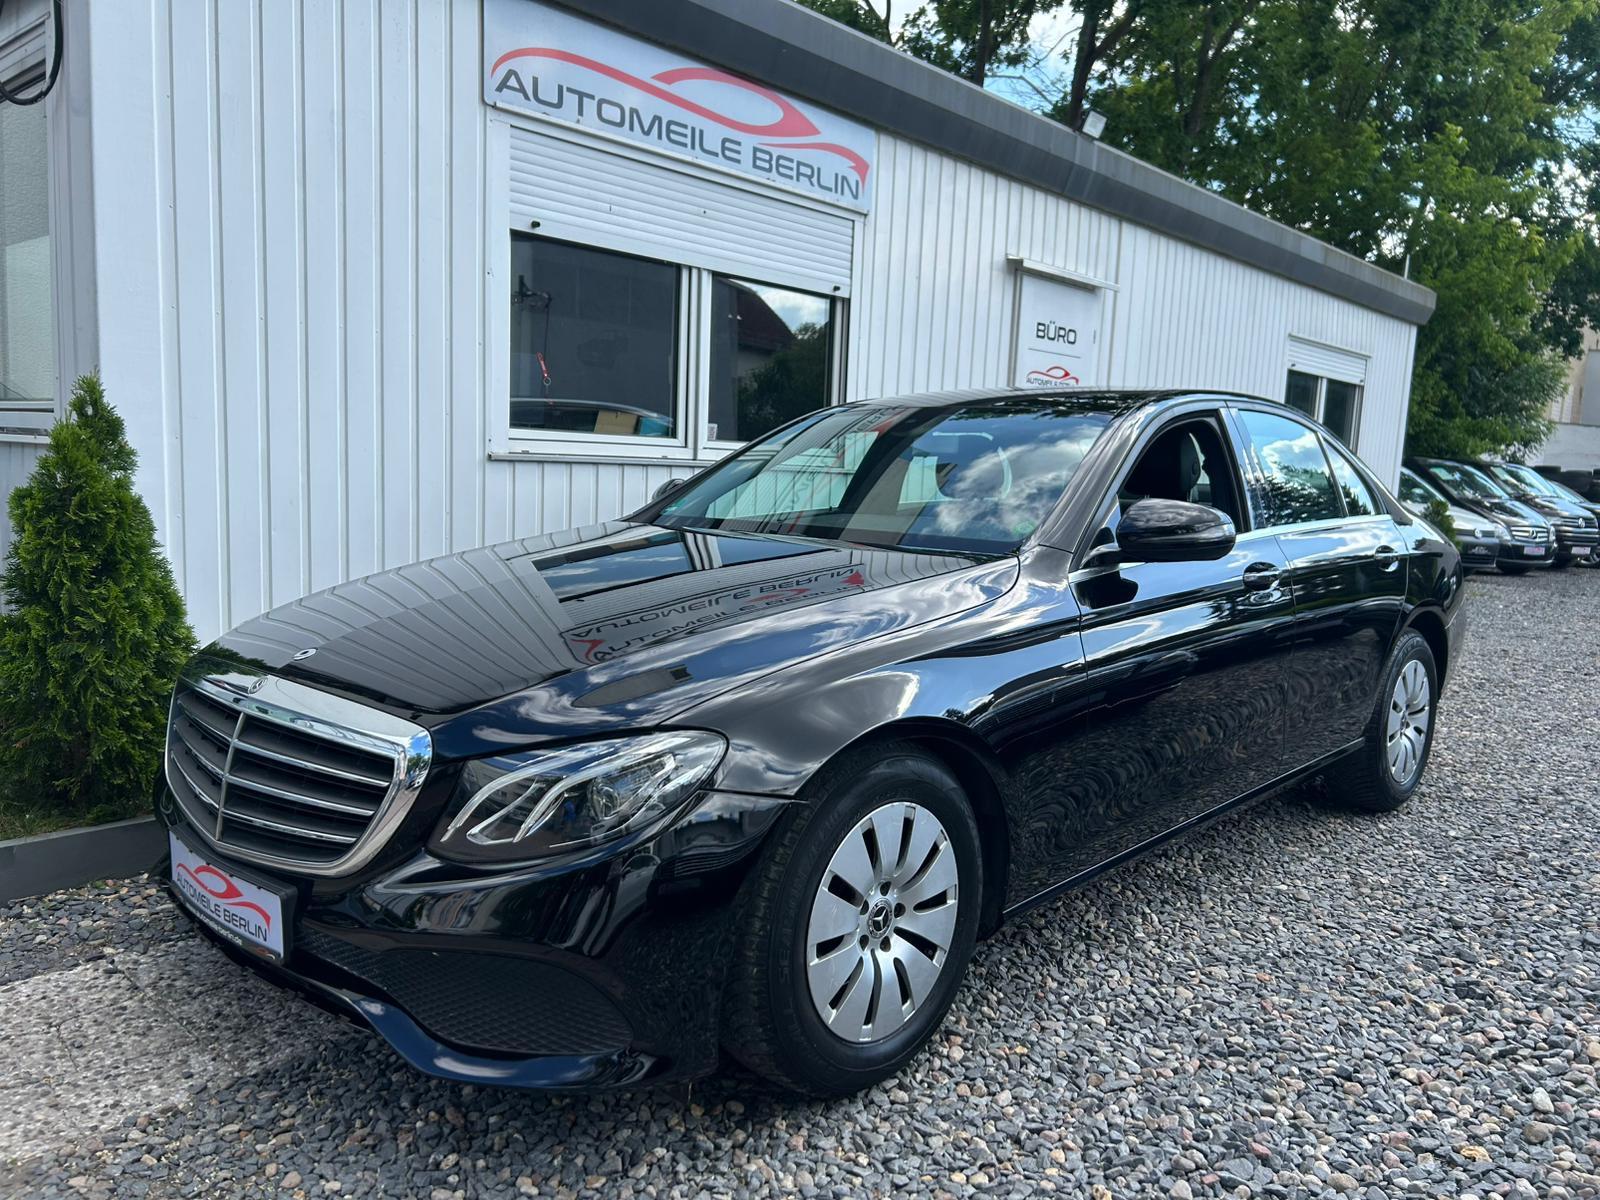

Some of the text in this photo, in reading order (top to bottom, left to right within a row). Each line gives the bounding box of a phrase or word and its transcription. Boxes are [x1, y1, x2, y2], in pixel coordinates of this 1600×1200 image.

[494, 69, 860, 200] AUTOMEILE BERLIN
[1036, 320, 1077, 345] BÜRO
[177, 871, 222, 918] AUTOMEILE
[223, 908, 268, 942] BERLIN
